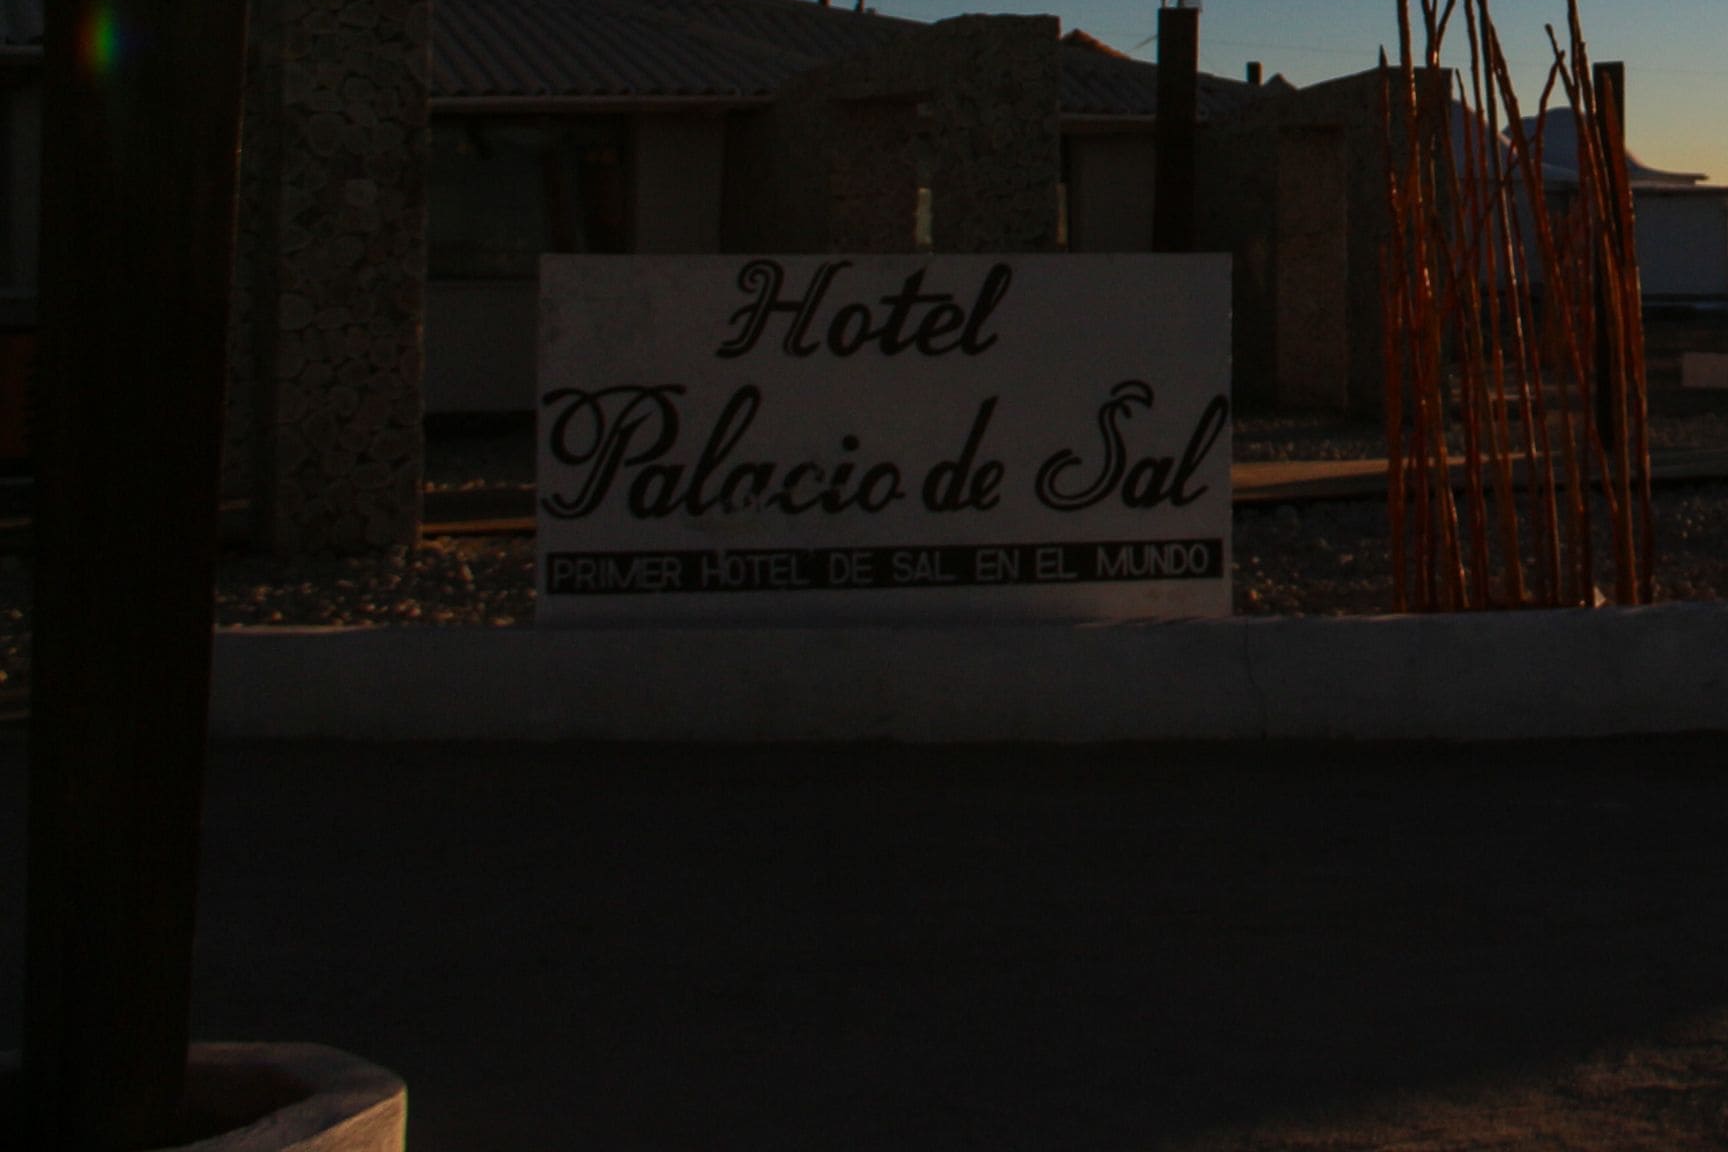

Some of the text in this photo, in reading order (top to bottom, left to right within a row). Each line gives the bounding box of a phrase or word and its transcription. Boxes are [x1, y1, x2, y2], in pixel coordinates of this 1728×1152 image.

[717, 259, 1012, 358] Hotel
[542, 381, 1229, 519] Palacio de Sal
[552, 544, 1209, 591] PRIMER HOTEL DE SAL EN EL MUNDO
